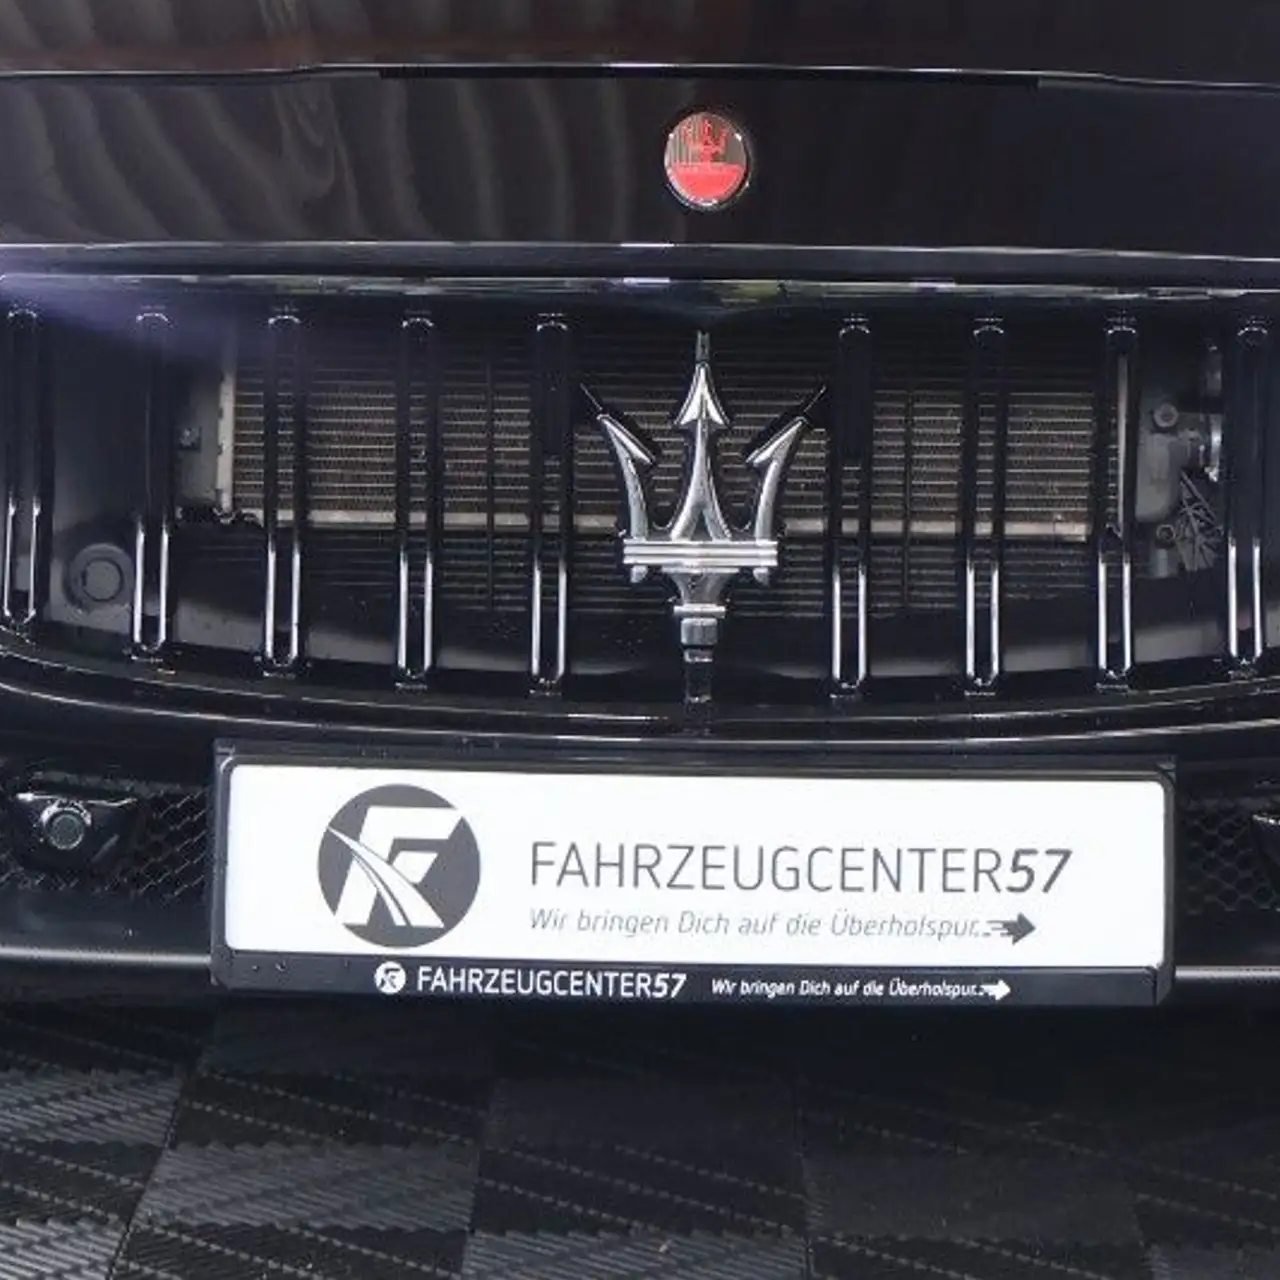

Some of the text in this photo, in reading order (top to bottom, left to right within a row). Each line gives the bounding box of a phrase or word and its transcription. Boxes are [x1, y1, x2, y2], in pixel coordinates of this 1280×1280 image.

[531, 841, 1073, 894] FAHRZEUGCENTER57
[530, 907, 568, 930] Wir
[577, 908, 669, 938] bringen
[678, 910, 730, 935] Dich
[738, 912, 779, 937] auf
[786, 913, 821, 937] die
[417, 965, 687, 999] FAHRZEUGCENTER57
[711, 978, 737, 995] Wir
[740, 979, 795, 999] bringen
[799, 980, 830, 996] Dich
[834, 980, 860, 996] auf
[863, 980, 884, 997] die
